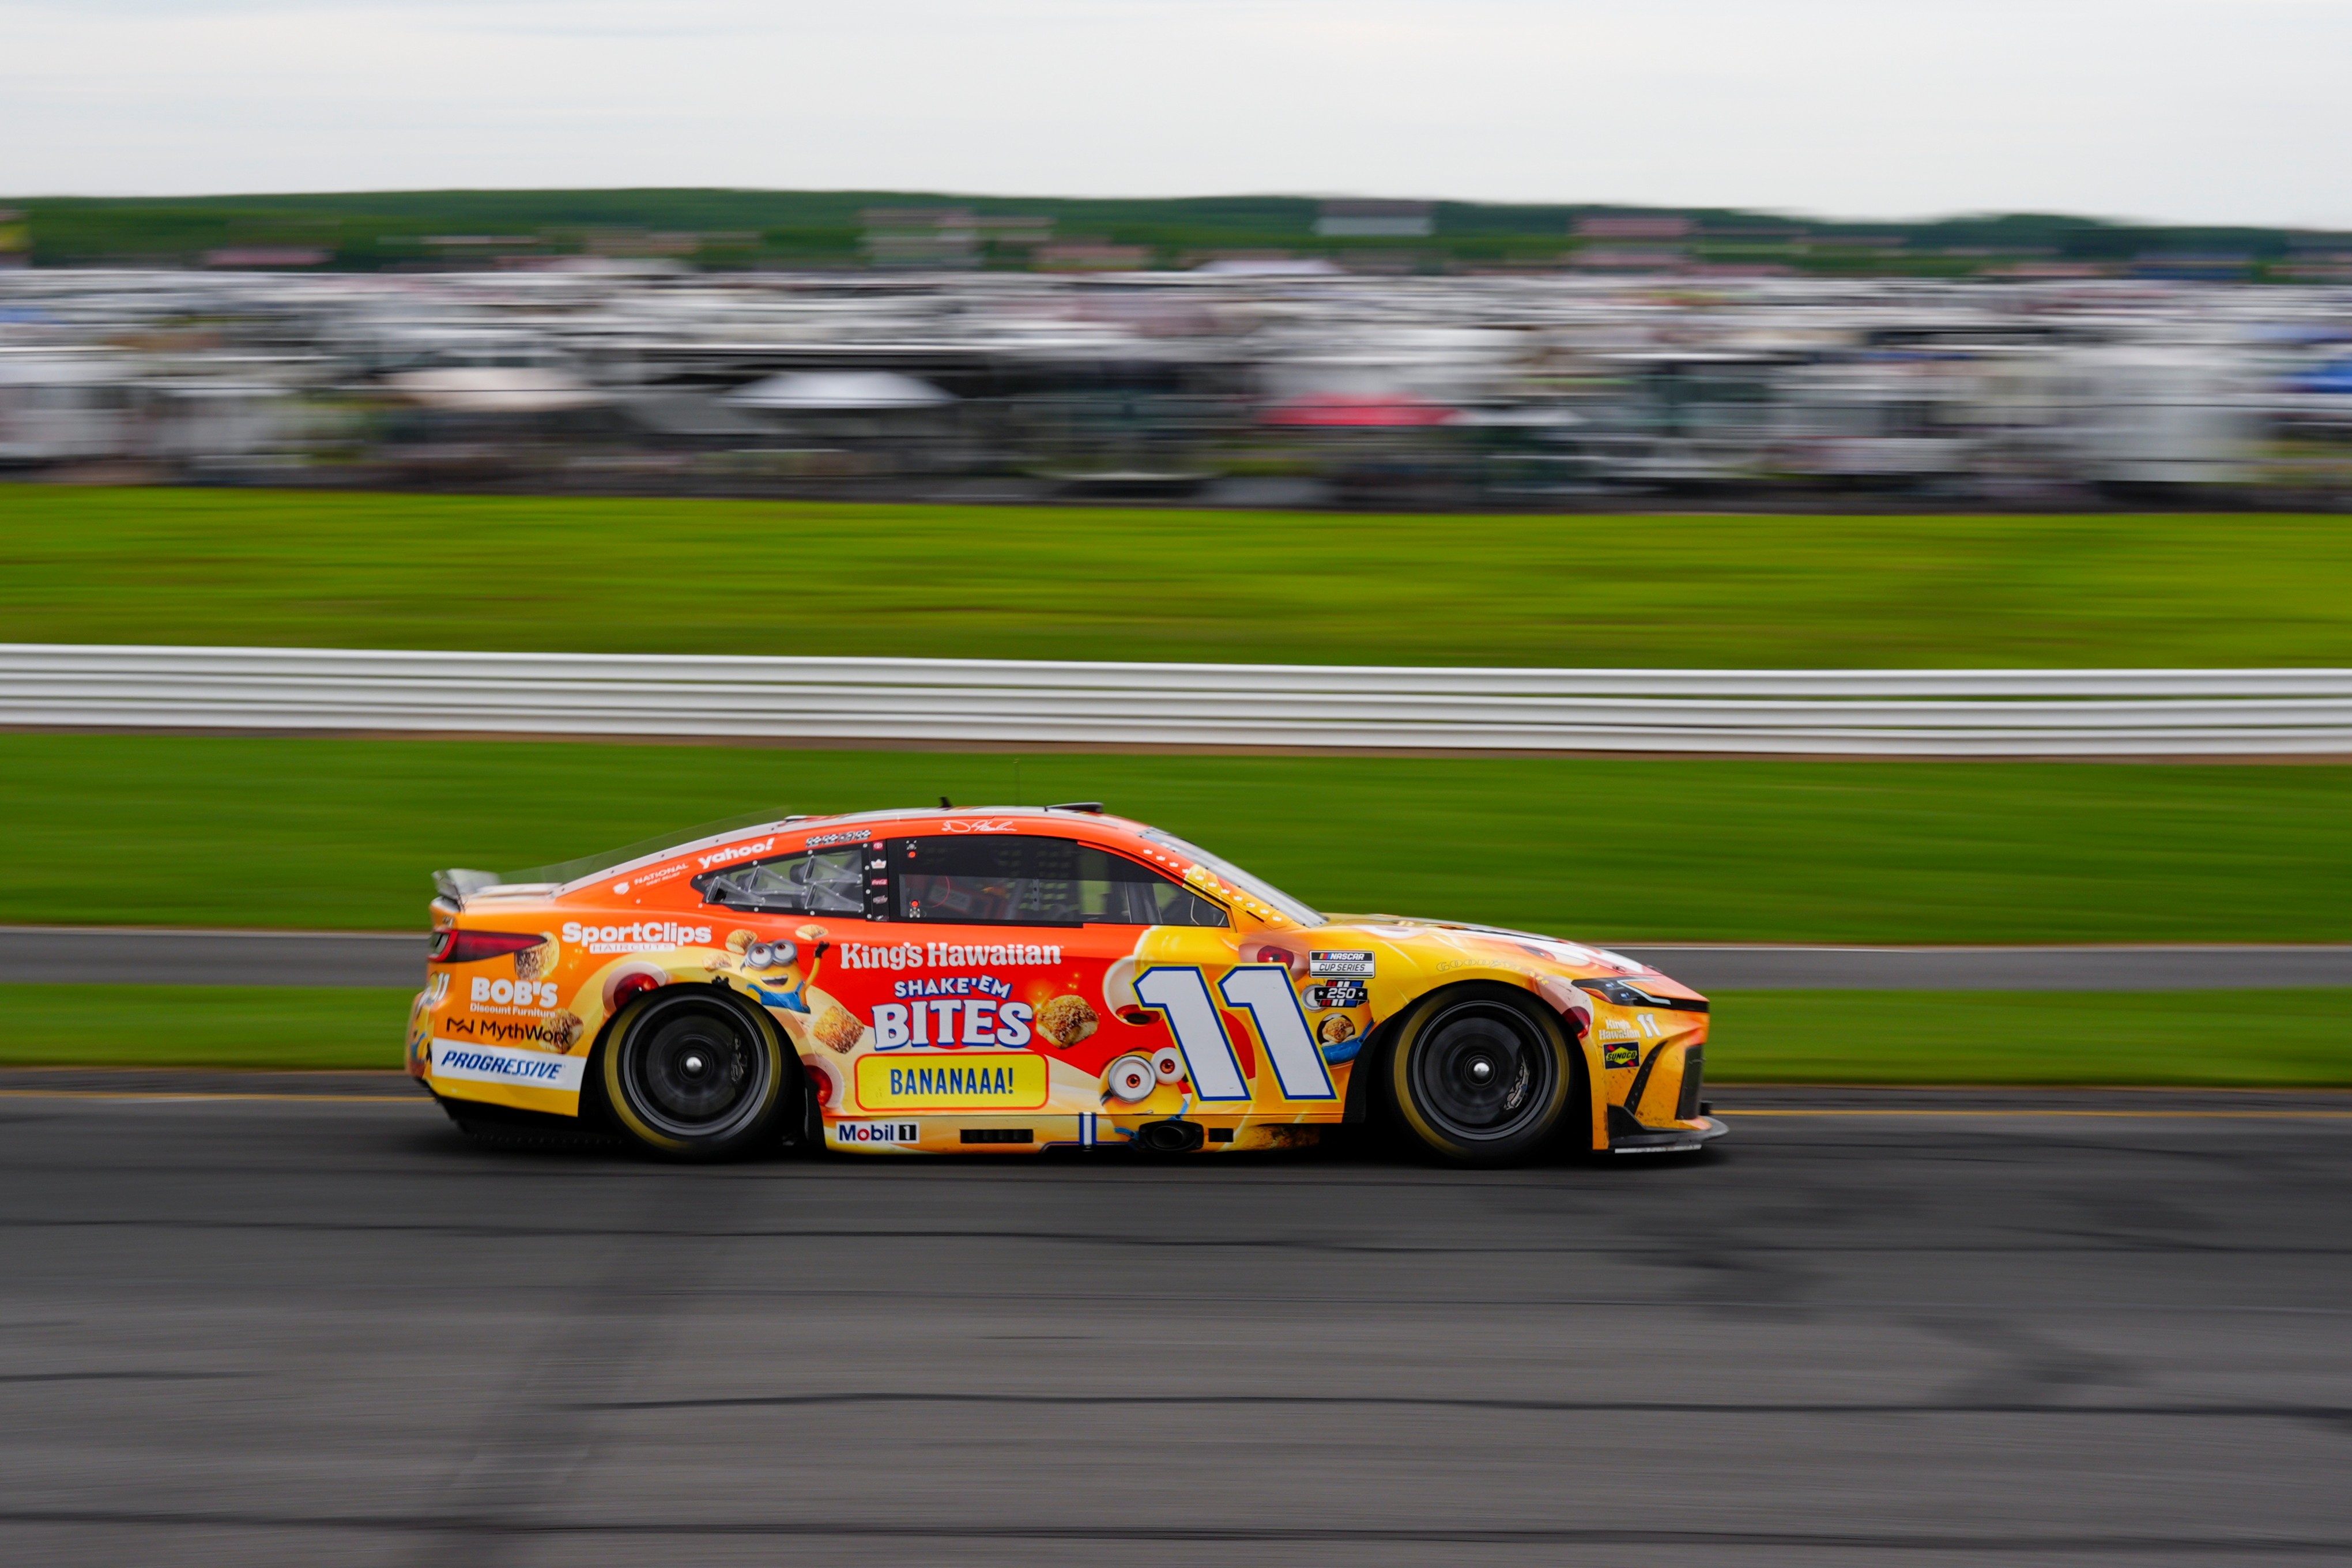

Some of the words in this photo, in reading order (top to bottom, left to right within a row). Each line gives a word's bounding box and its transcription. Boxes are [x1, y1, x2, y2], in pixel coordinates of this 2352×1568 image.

[698, 838, 775, 869] yahoo!
[634, 863, 689, 885] NATIONAL
[562, 922, 712, 947] SportClips
[840, 941, 924, 971] King's
[926, 942, 1062, 967] Hawaiian
[1319, 963, 1336, 971] CUP
[1336, 963, 1366, 971] SERIES
[470, 976, 559, 1009] BOB'S
[1326, 987, 1356, 999] 250
[470, 1002, 511, 1016] Discount
[512, 1005, 556, 1018] Furniture
[871, 999, 1034, 1051] BITES
[1131, 963, 1340, 1102] 11
[1637, 1013, 1662, 1038] 11
[442, 1050, 562, 1080] PROGRESSIVE
[1607, 1051, 1636, 1061] SUNOCO
[890, 1068, 1014, 1095] BANANAAA!
[839, 1125, 894, 1141] Mobil
